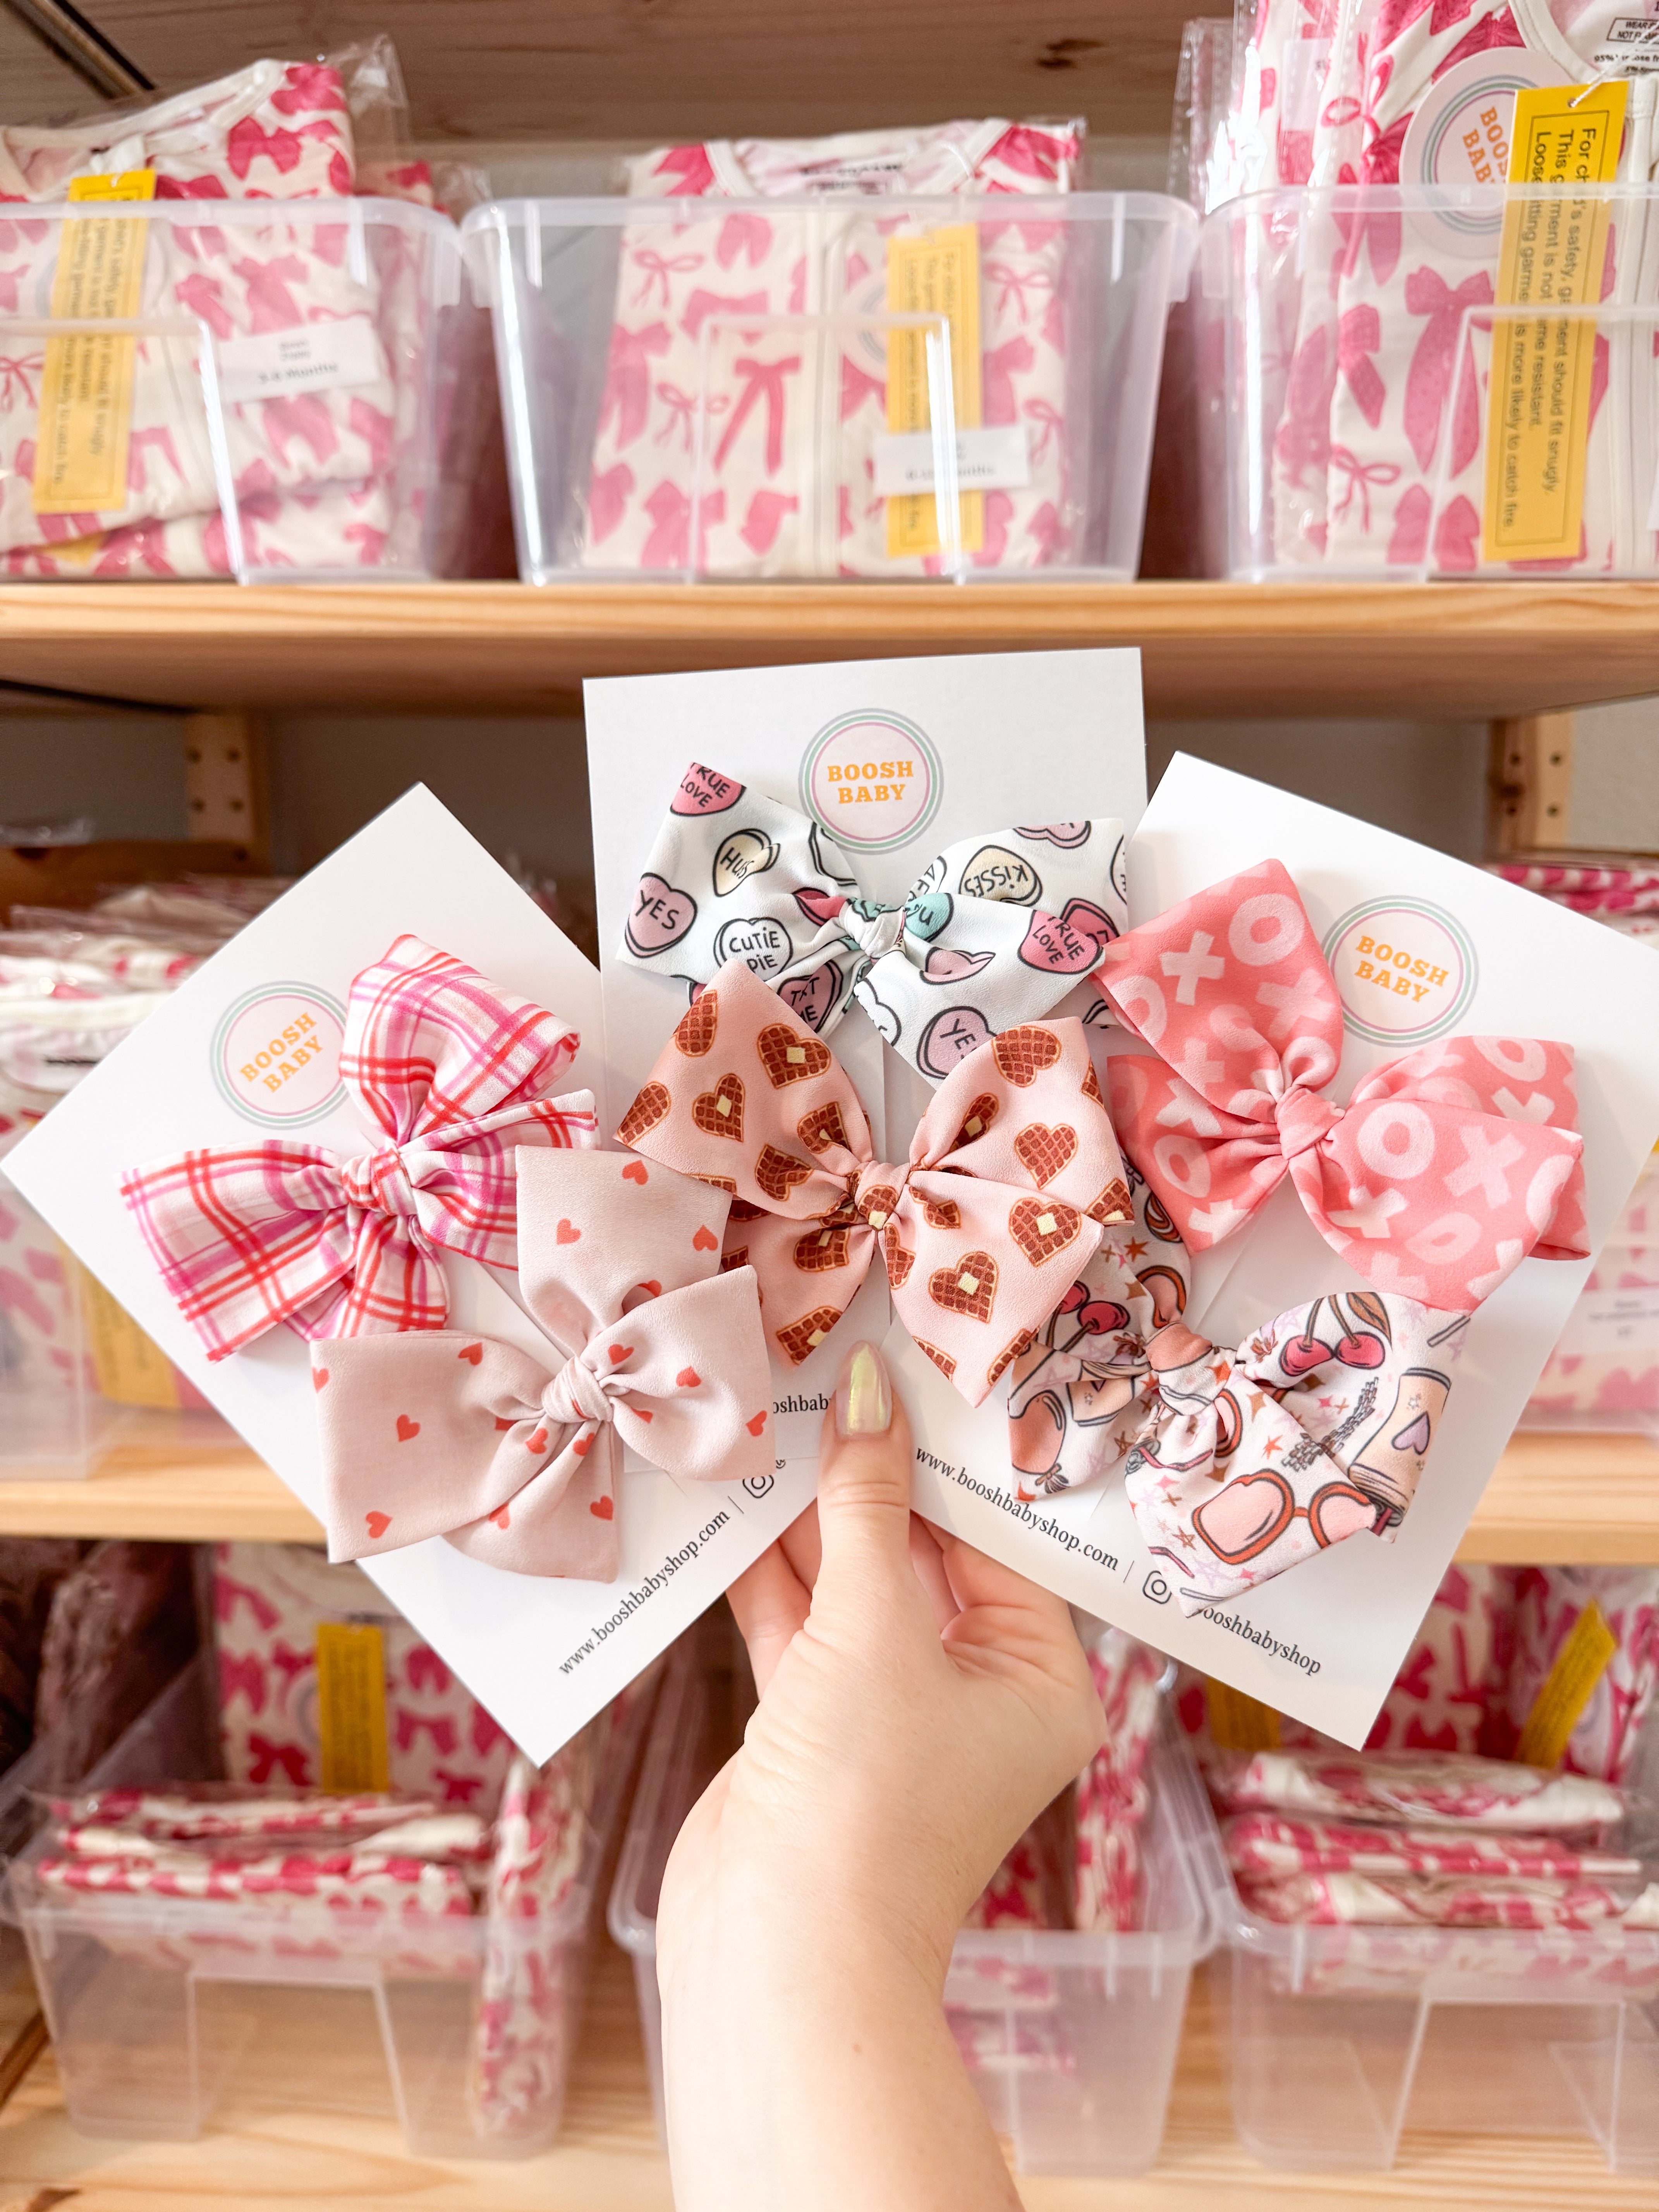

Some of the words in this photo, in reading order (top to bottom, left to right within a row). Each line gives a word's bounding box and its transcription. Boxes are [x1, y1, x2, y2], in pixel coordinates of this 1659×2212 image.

[1463, 129, 1495, 183] BAB
[1555, 129, 1574, 169] This
[1578, 128, 1596, 159] For
[1546, 174, 1565, 248] gment
[1543, 252, 1559, 267] is
[1539, 272, 1553, 299] not
[1554, 287, 1571, 356] gment
[1512, 341, 1525, 385] more
[1505, 387, 1525, 429] likely
[1550, 361, 1566, 416] should
[1507, 433, 1521, 451] to
[1549, 420, 1563, 435] fit
[1505, 453, 1519, 498] catch
[680, 773, 713, 807] LOVE
[690, 762, 730, 798] RUE
[827, 761, 913, 782] BOOSH
[838, 783, 906, 804] BABY
[635, 890, 680, 930] YES
[1032, 925, 1064, 965] LOVE
[1048, 916, 1084, 960] RUE
[1354, 960, 1430, 1003] BABY
[1355, 935, 1449, 987] BOOSH
[240, 1012, 317, 1083] BOOSH
[939, 1018, 979, 1060] YE
[262, 1034, 323, 1093] BABY
[916, 1447, 1119, 1571] www.booshbabyshop.com
[1203, 1607, 1321, 1676] ooshbabyshop
[559, 1511, 731, 1675] www.booshbabyshop.com
